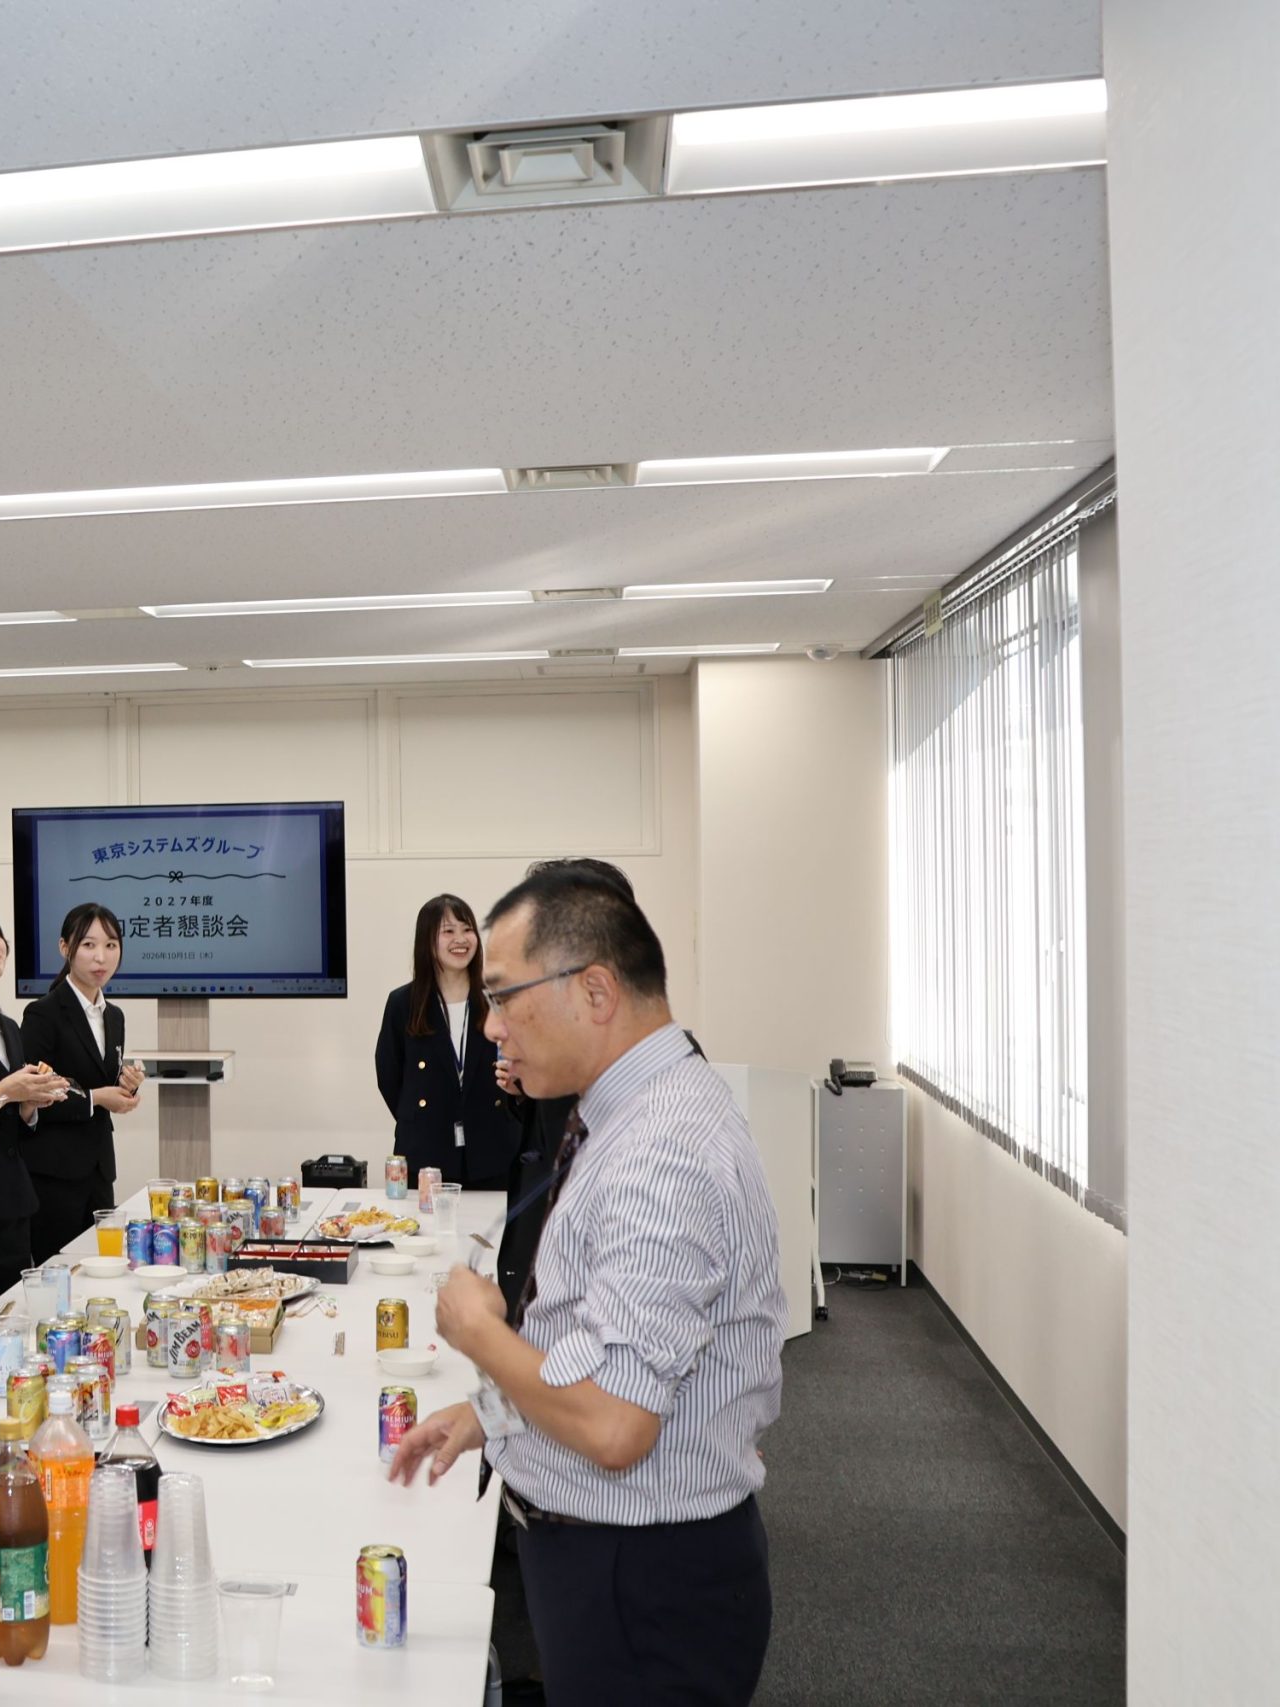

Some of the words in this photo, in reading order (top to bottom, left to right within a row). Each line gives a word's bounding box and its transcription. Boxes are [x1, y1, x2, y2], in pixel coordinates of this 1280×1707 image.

[92, 836, 265, 865] 東京システムズグループ
[143, 895, 214, 907] 2027年度
[173, 1320, 202, 1345] BEAM
[169, 1340, 181, 1365] JIM
[381, 1413, 415, 1424] PREMIUM
